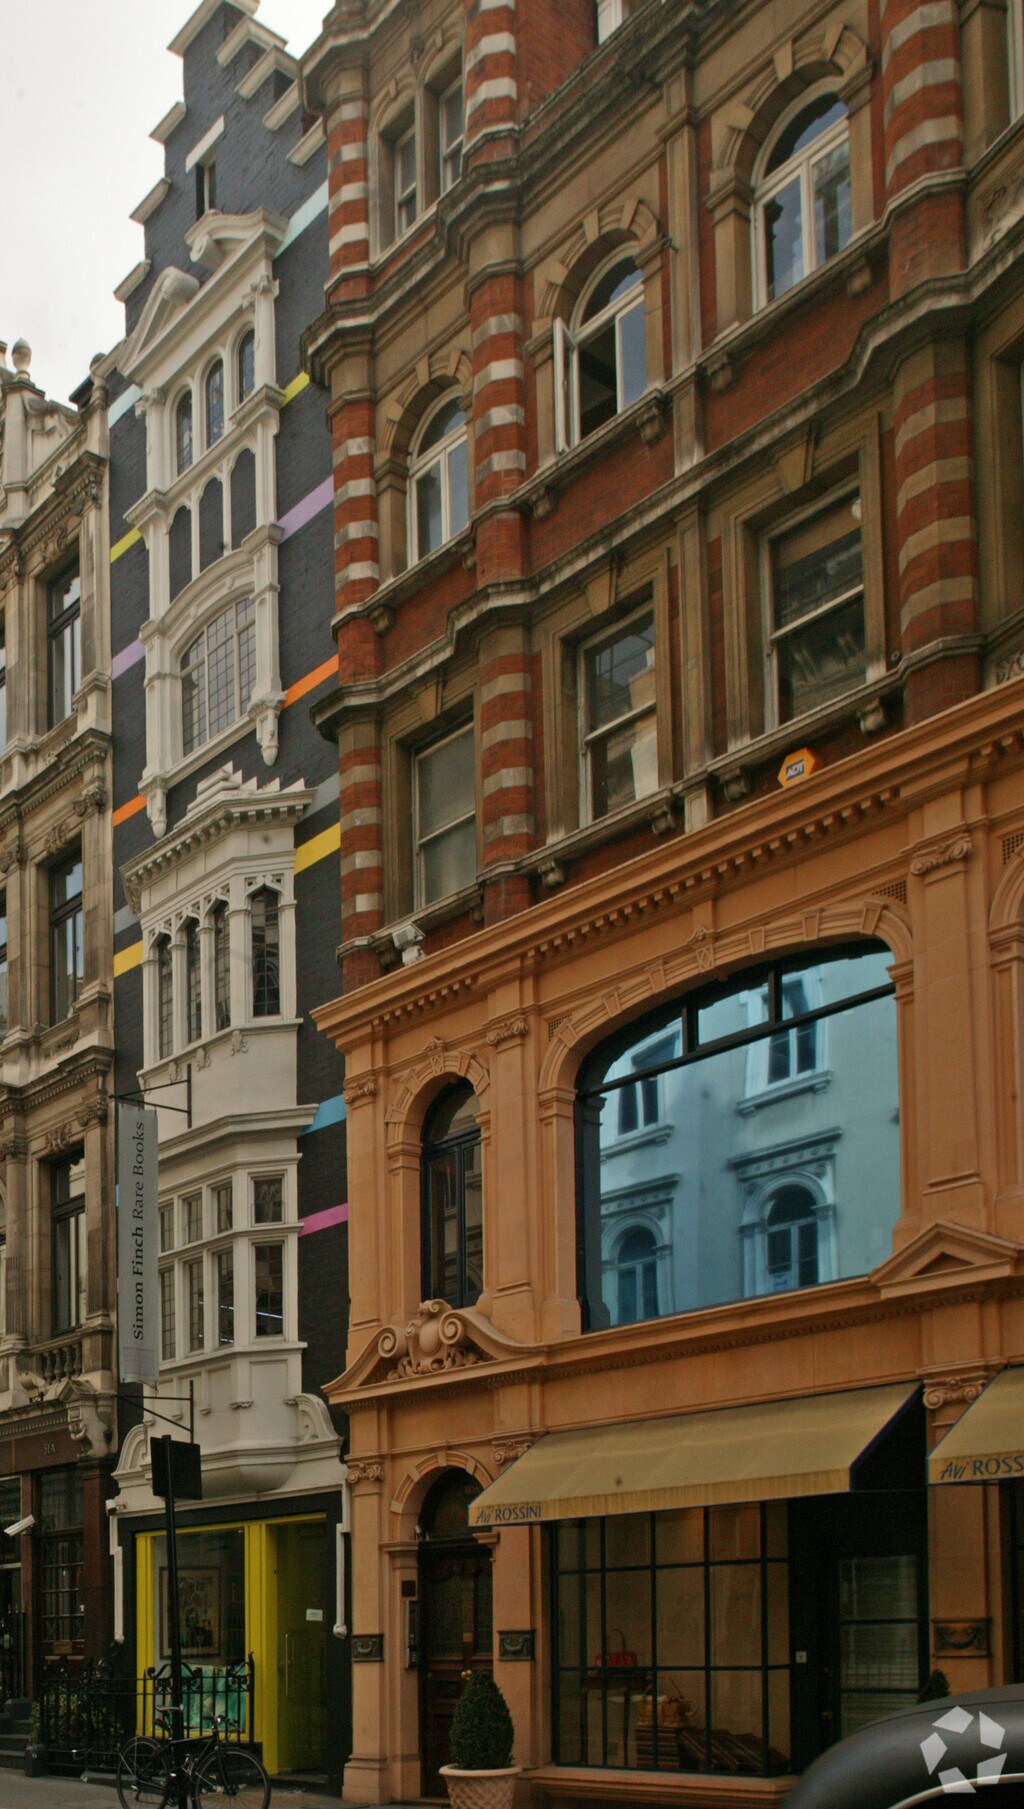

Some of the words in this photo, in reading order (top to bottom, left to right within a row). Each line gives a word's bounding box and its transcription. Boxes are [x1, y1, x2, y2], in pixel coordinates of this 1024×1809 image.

[787, 760, 805, 778] ADT
[132, 1121, 145, 1176] Books
[132, 1181, 144, 1220] Rare
[131, 1225, 144, 1277] Finch
[133, 1281, 144, 1340] Simon
[940, 1461, 969, 1480] Avi
[495, 1504, 542, 1521] ROSSINI
